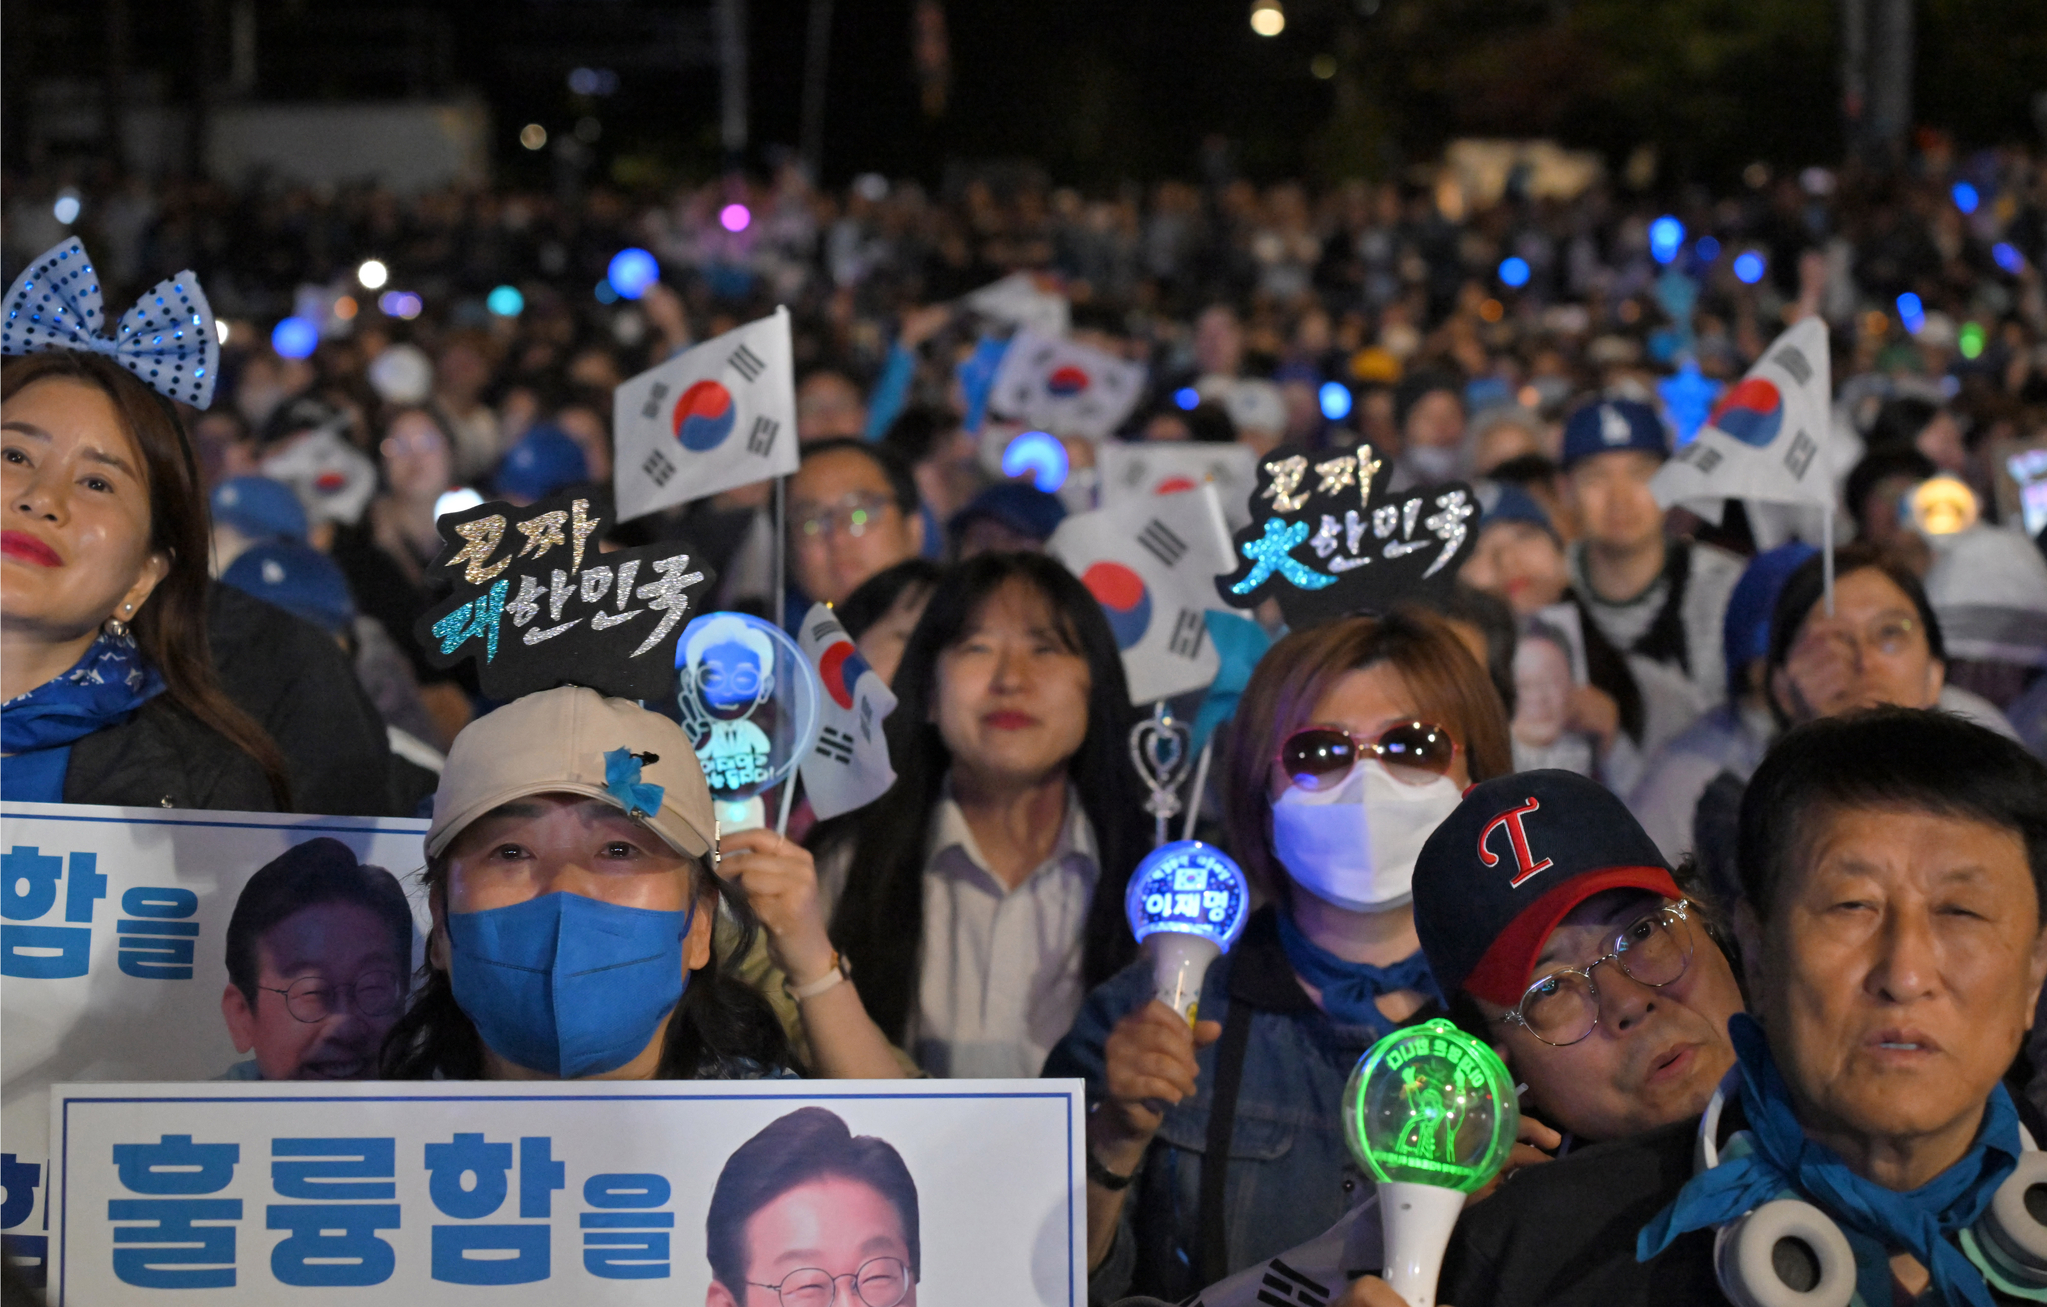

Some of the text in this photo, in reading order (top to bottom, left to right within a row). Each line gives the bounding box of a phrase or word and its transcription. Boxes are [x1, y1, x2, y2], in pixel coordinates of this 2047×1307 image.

[1261, 444, 1382, 514] 진짜
[445, 498, 601, 585] 진짜
[1229, 490, 1474, 594] 大한민국
[431, 554, 704, 665] 대한민국
[1477, 796, 1553, 889] T
[0, 845, 200, 980] 함을
[1145, 890, 1229, 922] 이재명
[108, 1132, 675, 1289] 훌륭함을
